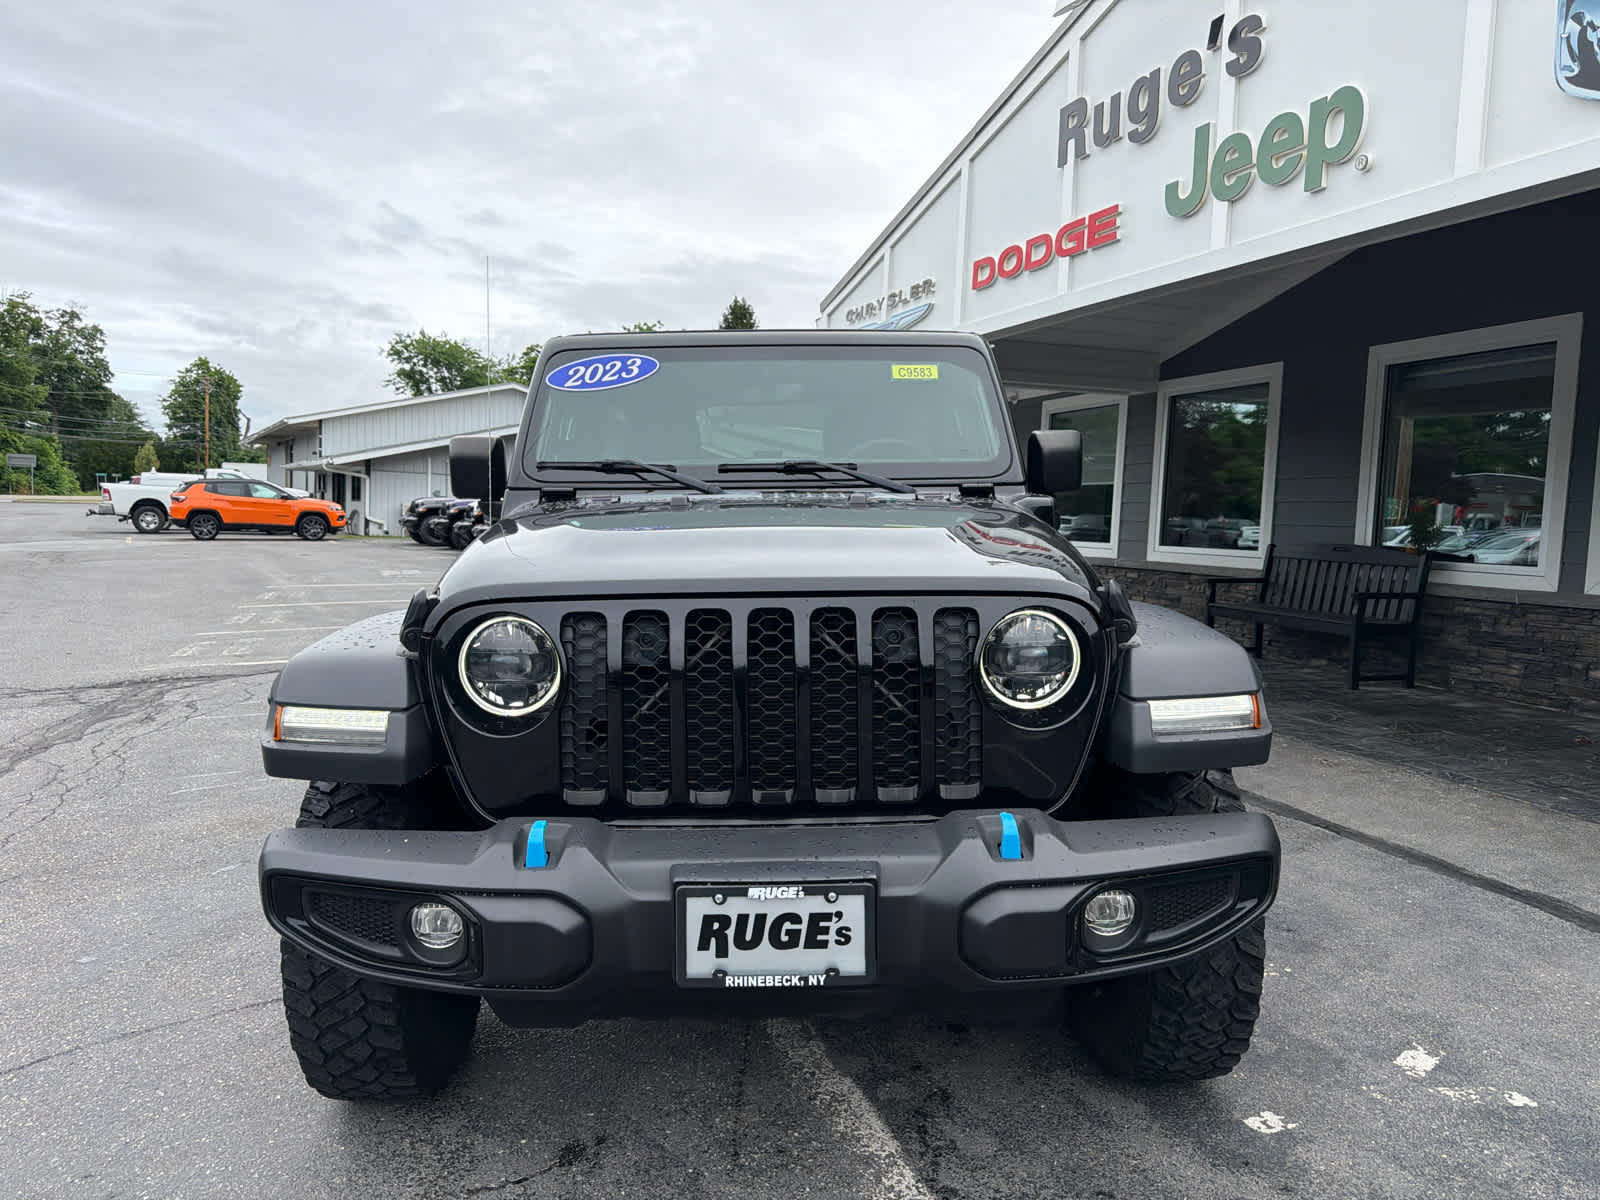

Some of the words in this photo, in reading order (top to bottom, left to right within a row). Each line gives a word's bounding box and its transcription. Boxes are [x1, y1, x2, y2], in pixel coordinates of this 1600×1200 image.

[1057, 14, 1267, 168] Ruge's
[1165, 85, 1366, 217] Jeep
[972, 204, 1122, 290] DODGE
[846, 279, 936, 324] CHRYSLER
[564, 358, 642, 387] 2023
[898, 367, 933, 378] C9583
[697, 911, 851, 958] RUGE's
[725, 976, 804, 987] RHINEBECK,
[809, 975, 827, 986] NY
